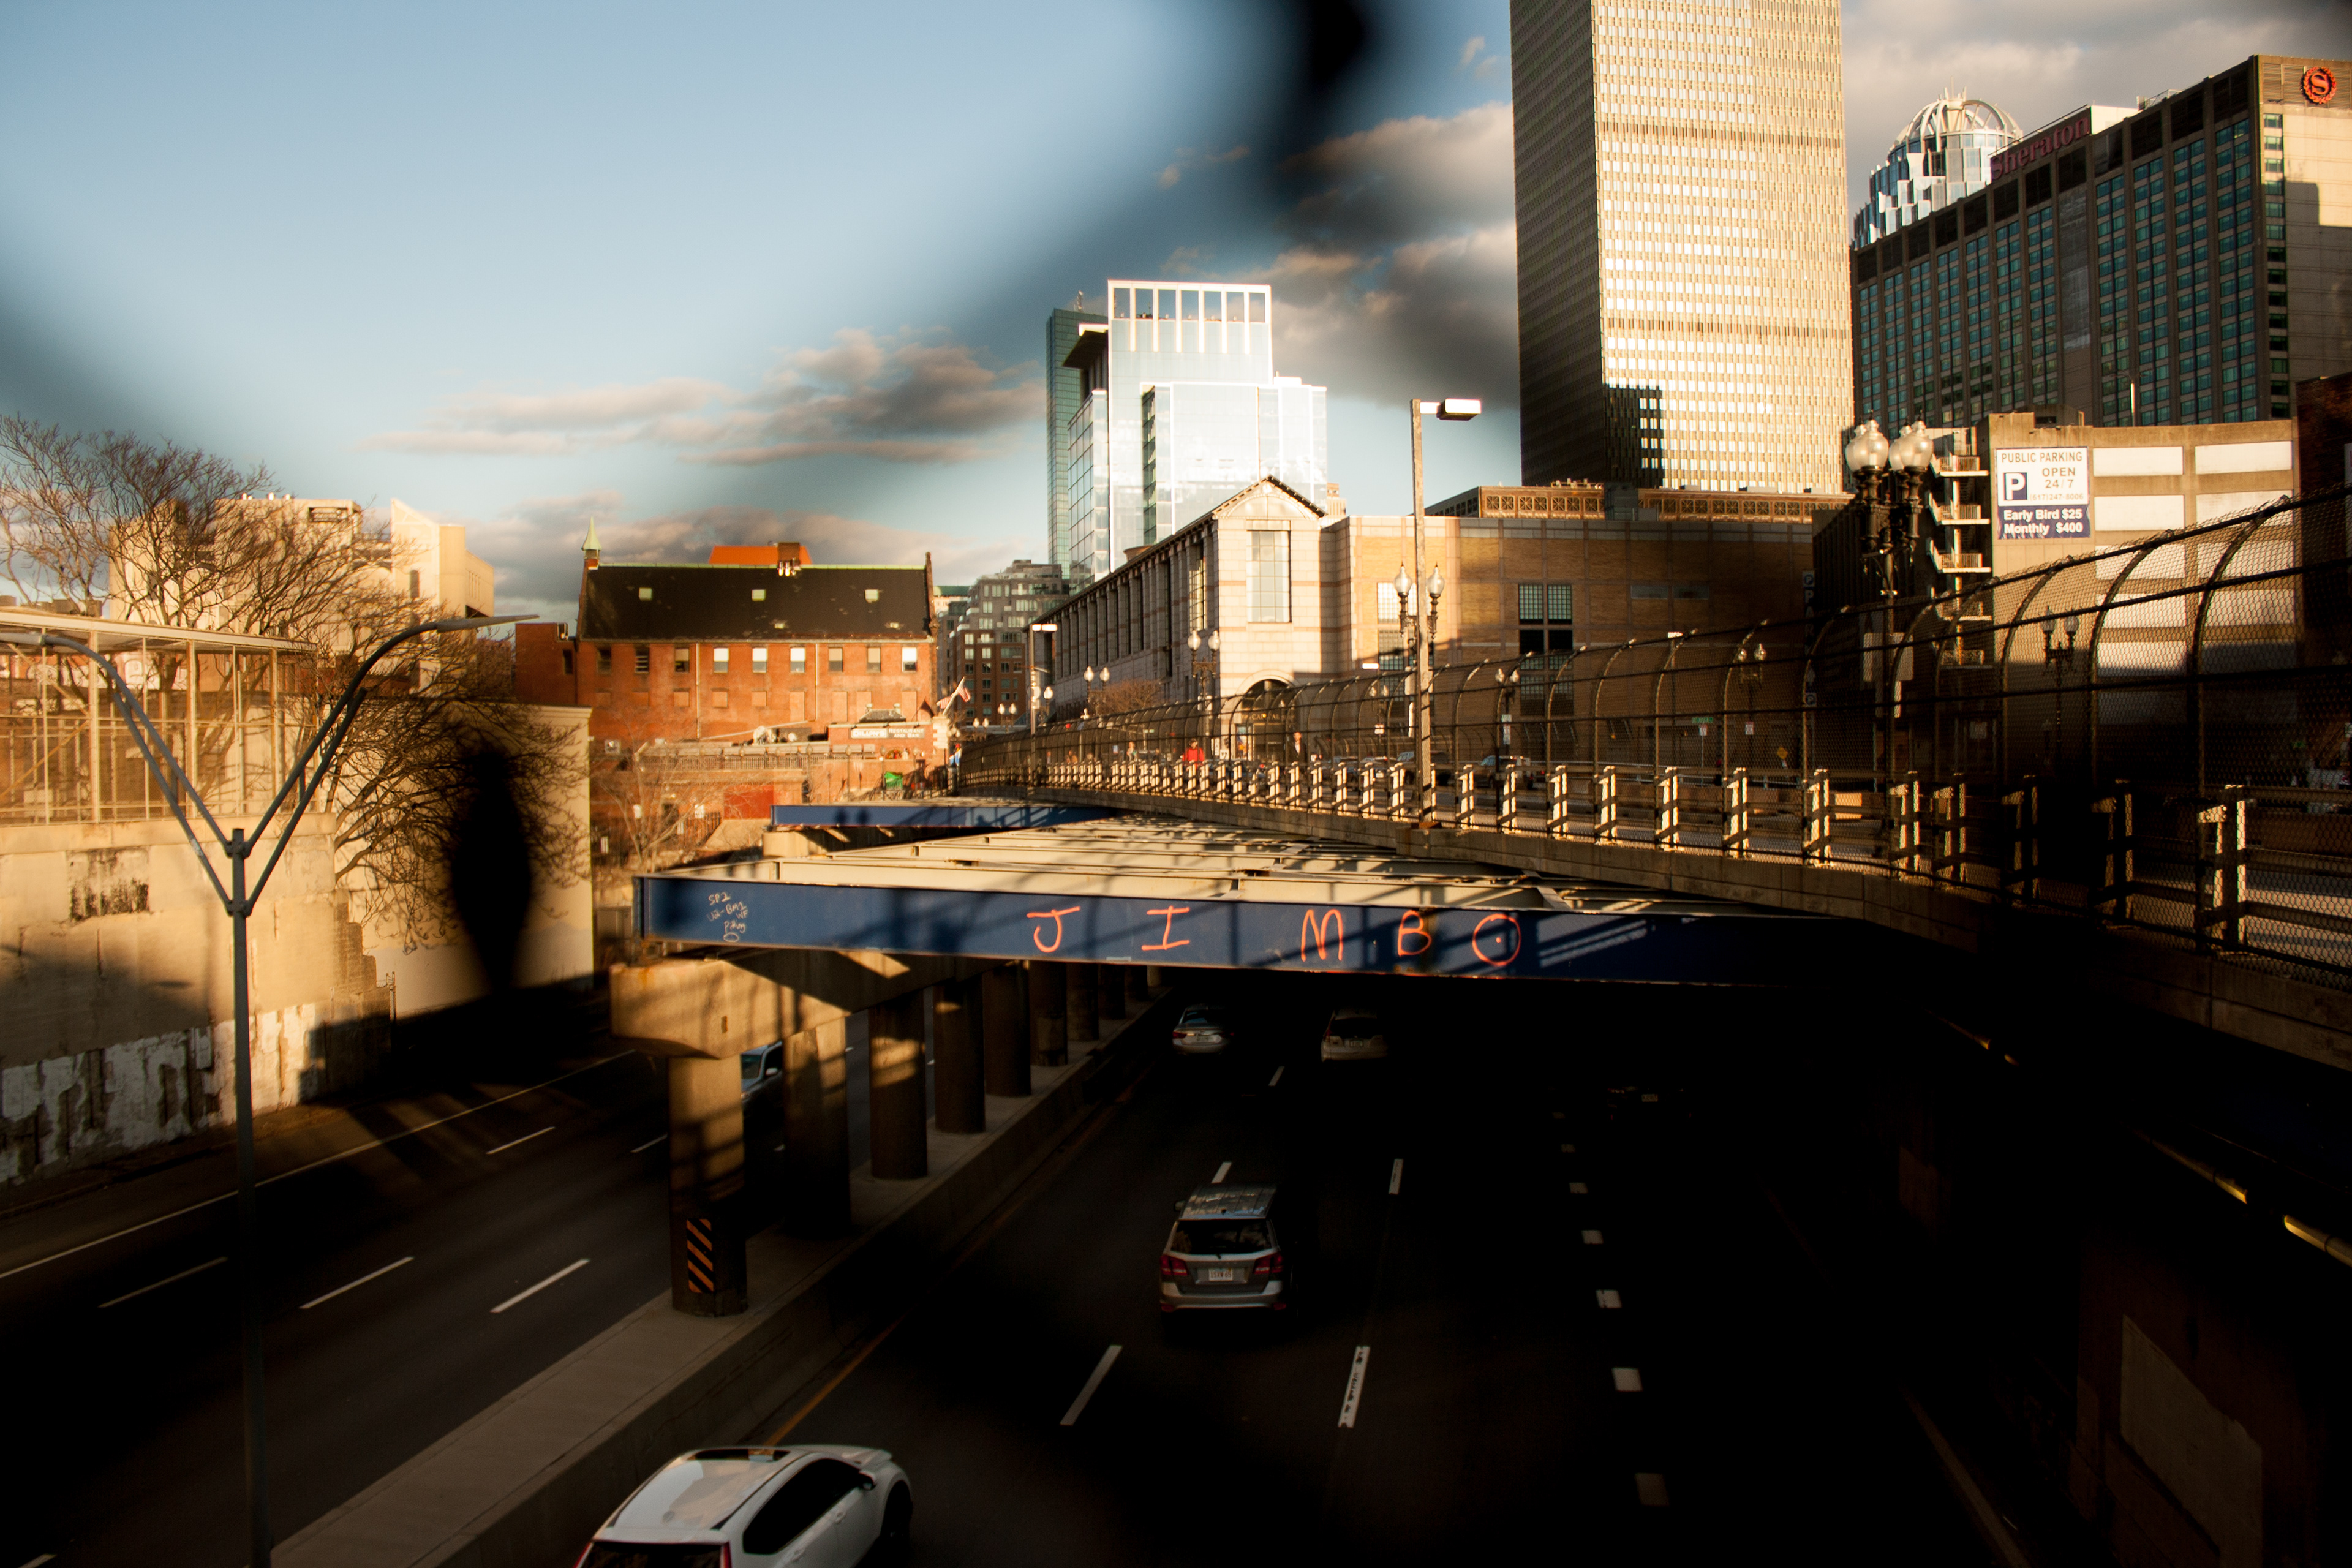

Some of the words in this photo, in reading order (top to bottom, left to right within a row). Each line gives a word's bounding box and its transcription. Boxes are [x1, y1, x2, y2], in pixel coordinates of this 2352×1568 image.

[2311, 72, 2329, 95] S
[1991, 116, 2090, 181] Sheraton
[2002, 452, 2037, 463] PUBLIC
[2040, 451, 2082, 462] PARKING
[2042, 467, 2076, 477] OPEN
[2006, 472, 2026, 500] P
[2045, 479, 2074, 489] 24/7
[2003, 508, 2034, 522] Early
[2035, 508, 2059, 520] Bird
[2062, 508, 2082, 521] $25
[2003, 523, 2050, 536] Monthly
[2056, 522, 2083, 534] $400
